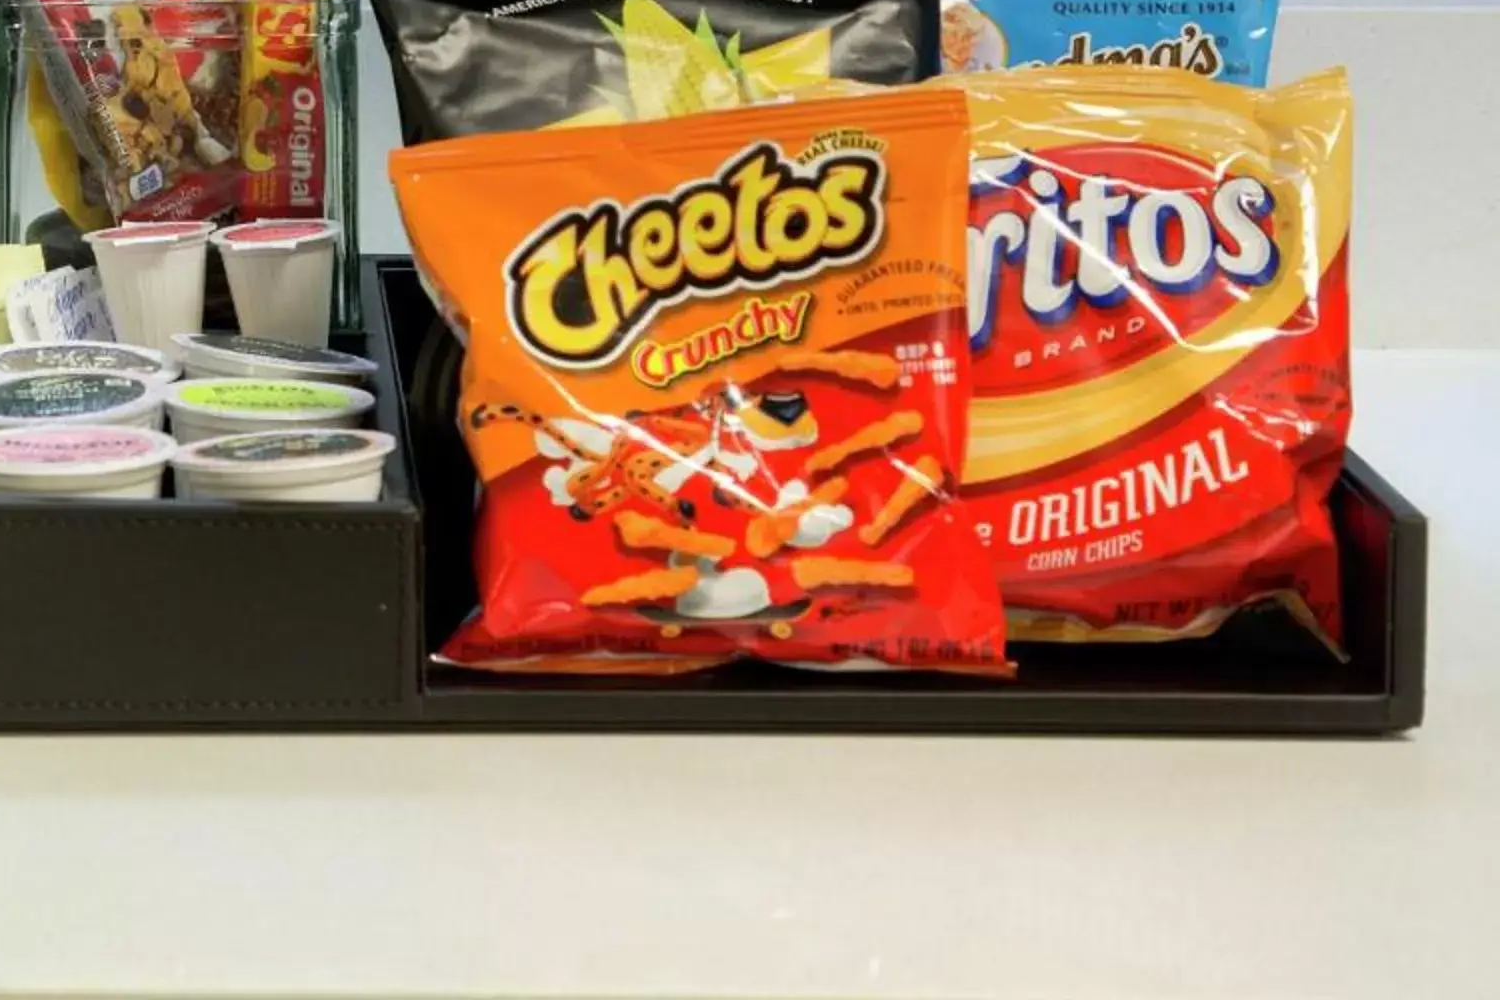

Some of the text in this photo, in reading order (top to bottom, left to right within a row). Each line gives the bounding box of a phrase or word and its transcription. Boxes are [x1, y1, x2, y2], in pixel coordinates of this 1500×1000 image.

[1052, 0, 1237, 15] QUALITY SINCE 1914
[289, 86, 317, 207] Original
[512, 147, 876, 360] Cheetos
[836, 259, 924, 304] GUARANTEED
[967, 156, 1280, 350] ritos
[632, 292, 811, 387] Crunchy
[1013, 315, 1147, 370] BRAND
[1007, 426, 1250, 546] ORIGINAL
[1028, 530, 1144, 572] CORN CHIPS
